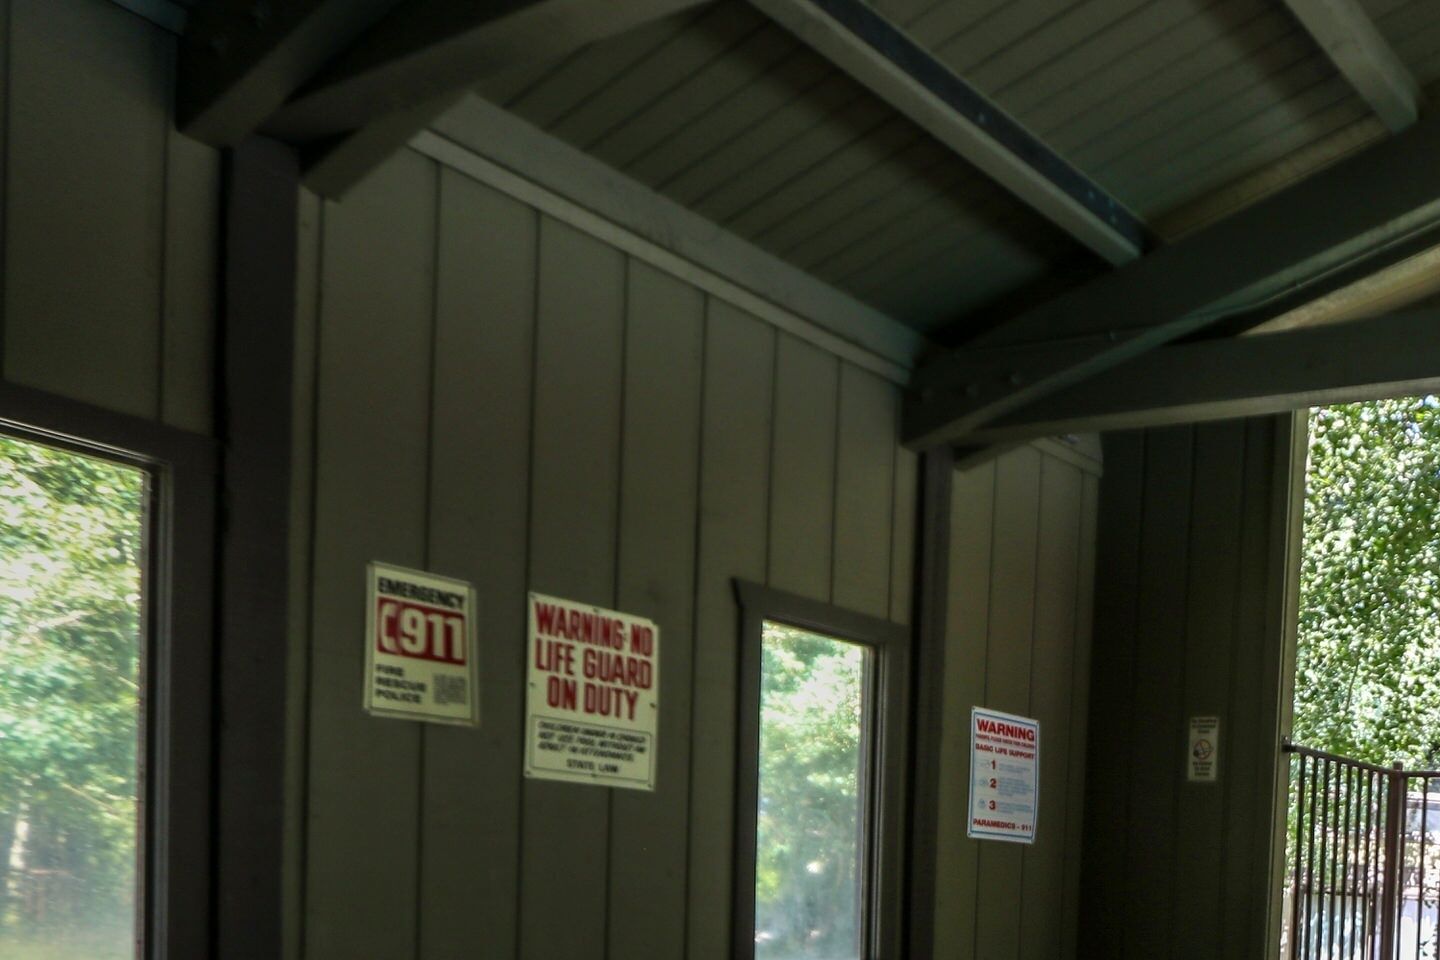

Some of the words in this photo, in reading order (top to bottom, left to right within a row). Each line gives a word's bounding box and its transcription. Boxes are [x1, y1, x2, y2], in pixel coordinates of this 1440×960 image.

[401, 607, 464, 660] 911
[630, 624, 654, 657] NO
[535, 638, 576, 675] LIFE
[583, 648, 653, 689] GUARD
[547, 676, 577, 712] ON
[584, 682, 639, 721] DUTY
[976, 718, 1035, 741] WARNING
[975, 743, 993, 753] BASIC
[995, 747, 1008, 755] LIFE
[1009, 749, 1035, 760] SUPPORT
[567, 758, 595, 771] STATE
[598, 762, 619, 774] LAW
[991, 760, 996, 770] 1
[989, 778, 997, 789] 2
[989, 800, 996, 811] 3
[973, 818, 1016, 831] PARAMEDICS
[1021, 824, 1032, 832] 911
